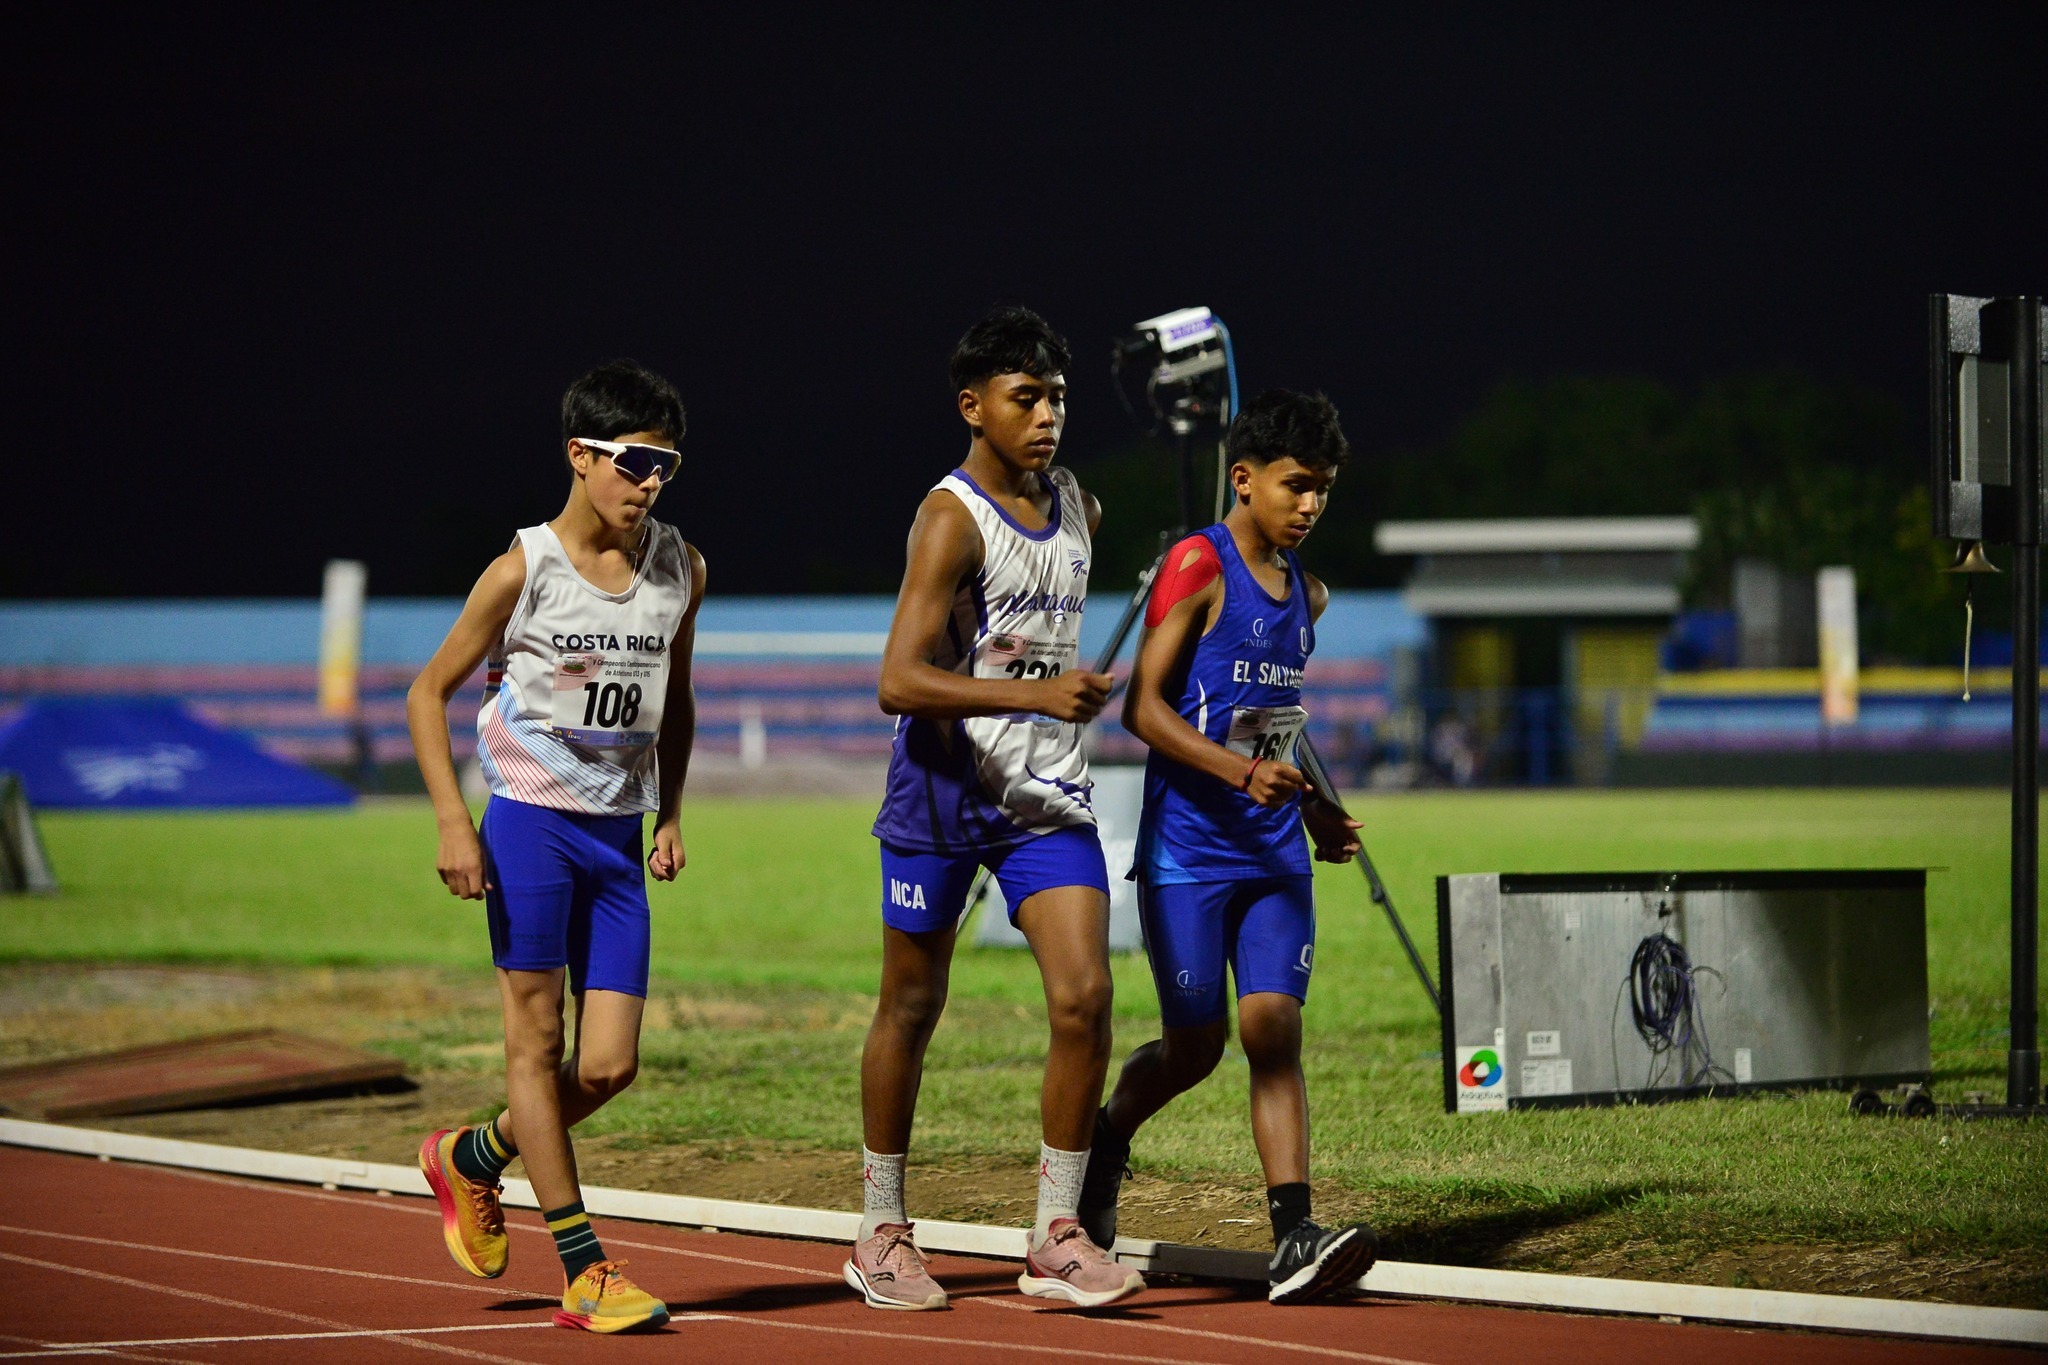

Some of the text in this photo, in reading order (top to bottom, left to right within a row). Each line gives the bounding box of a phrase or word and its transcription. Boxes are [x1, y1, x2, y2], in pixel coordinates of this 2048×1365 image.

[997, 589, 1086, 624] Naragu
[552, 634, 666, 652] COSTA RICA
[1244, 638, 1273, 648] INDES
[1233, 660, 1251, 683] EL
[583, 681, 643, 728] 108
[891, 878, 927, 910] NCA
